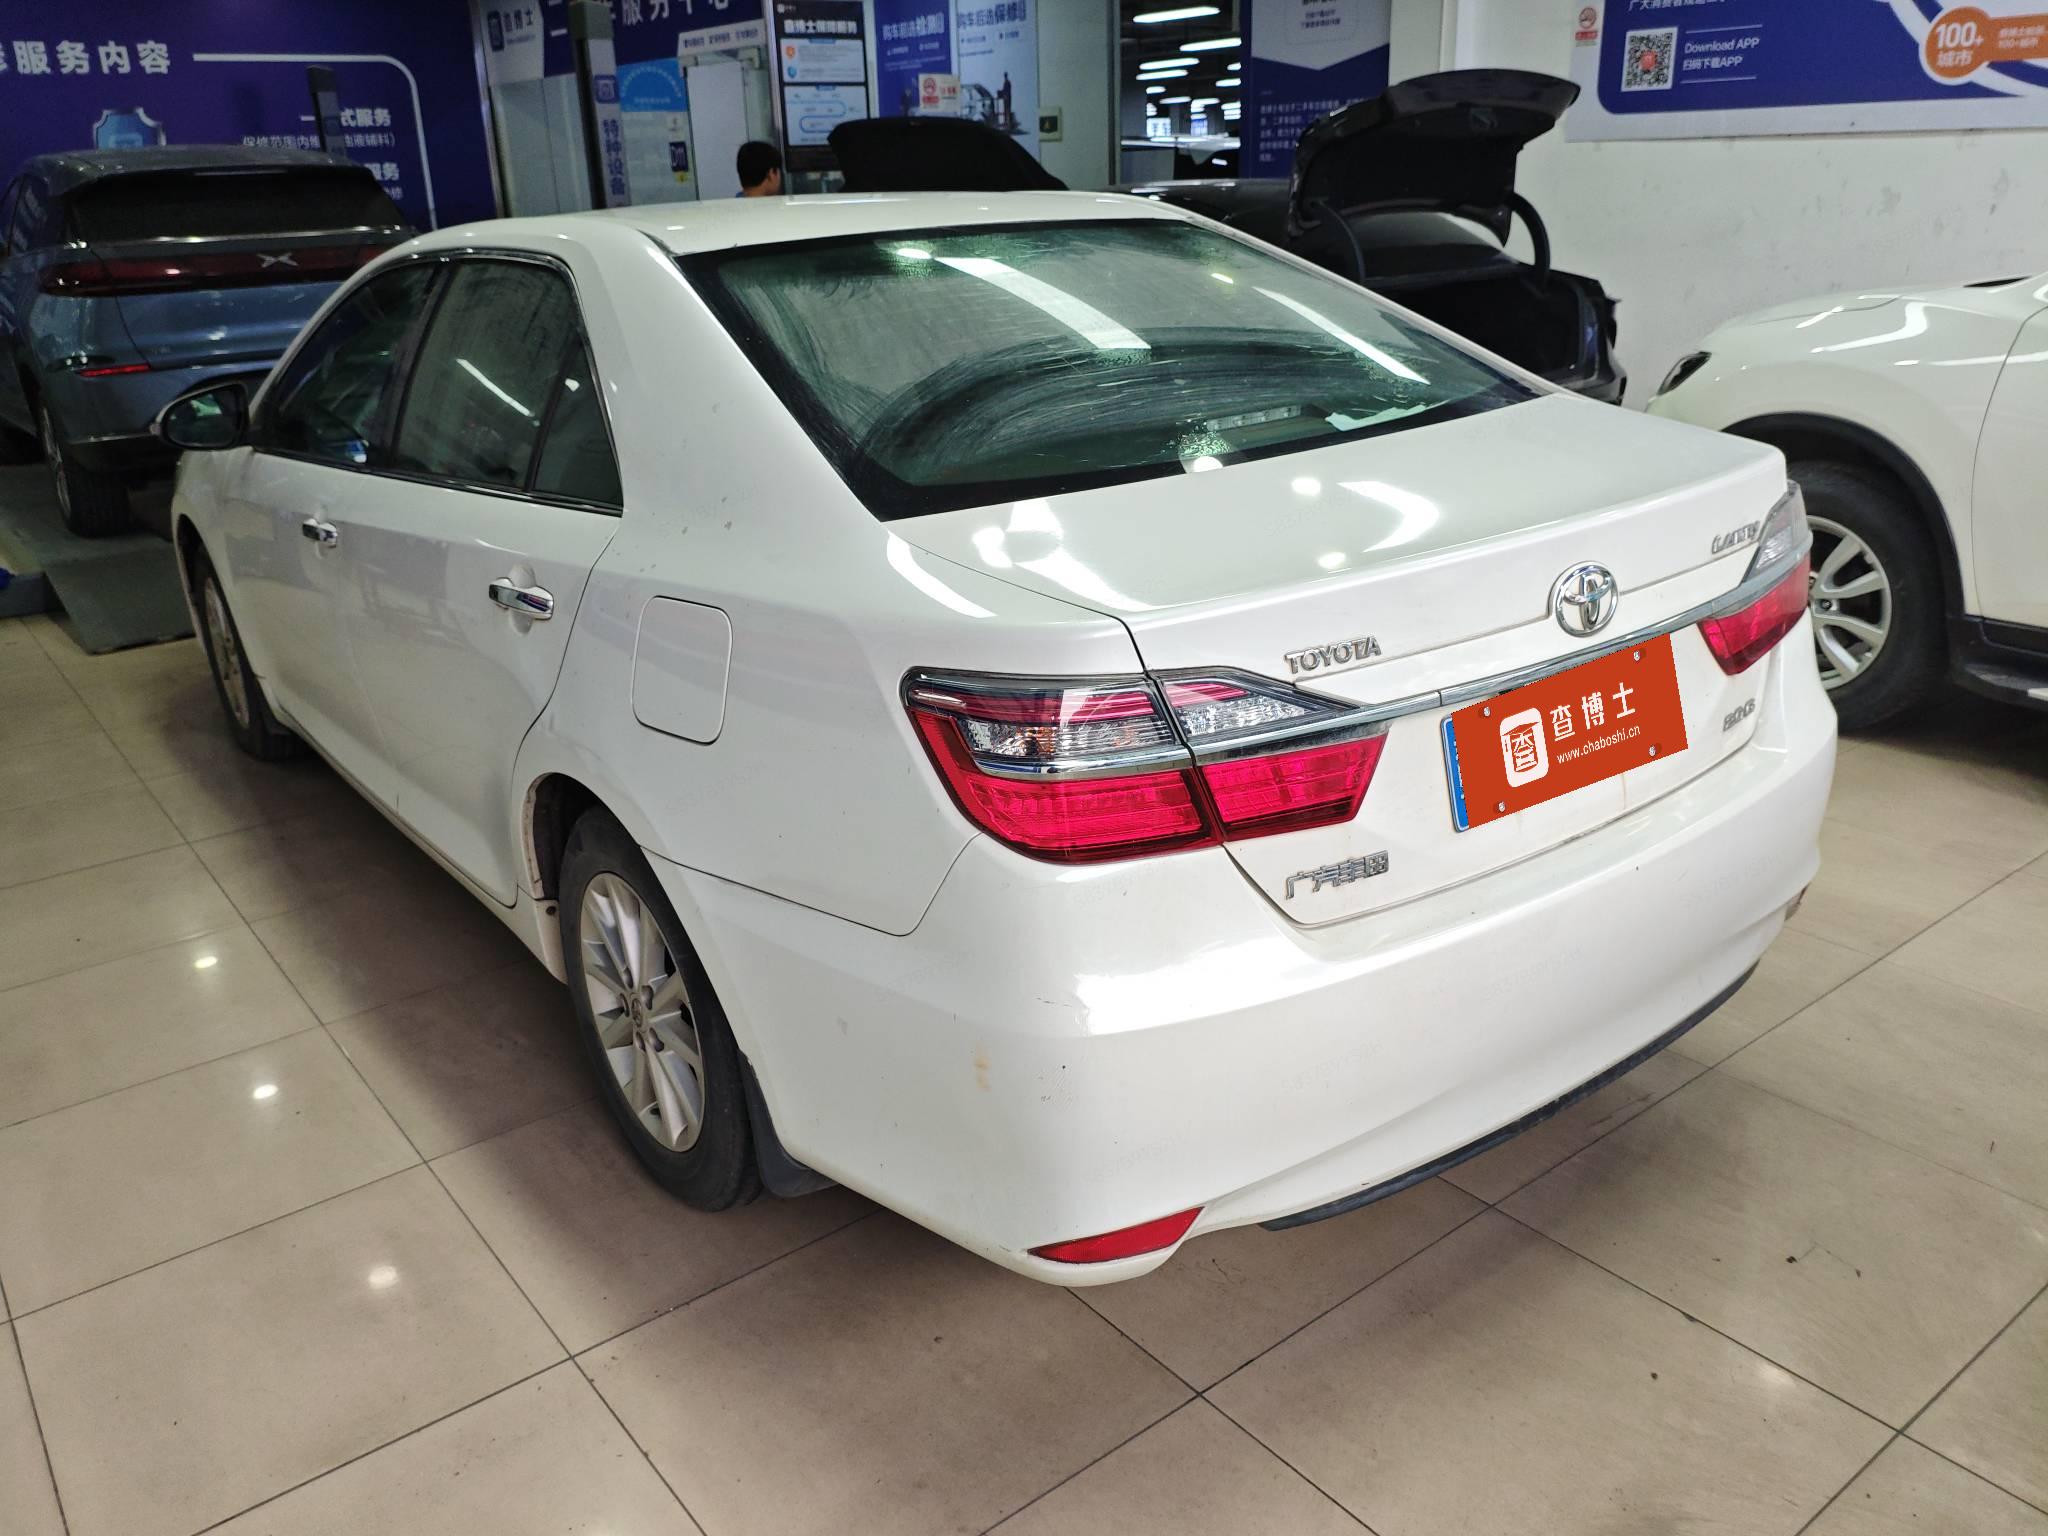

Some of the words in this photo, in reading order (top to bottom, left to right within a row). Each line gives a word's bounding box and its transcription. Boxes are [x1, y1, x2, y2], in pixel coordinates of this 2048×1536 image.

[1684, 39, 1735, 54] Download
[1735, 37, 1760, 49] APP
[1936, 21, 1984, 48] 100+
[0, 40, 171, 75] 服务内容
[1937, 50, 1973, 67] 城市
[301, 107, 391, 128] 一式服务
[1284, 636, 1382, 675] TOYOTA
[1285, 850, 1389, 900] 广汽丰田
